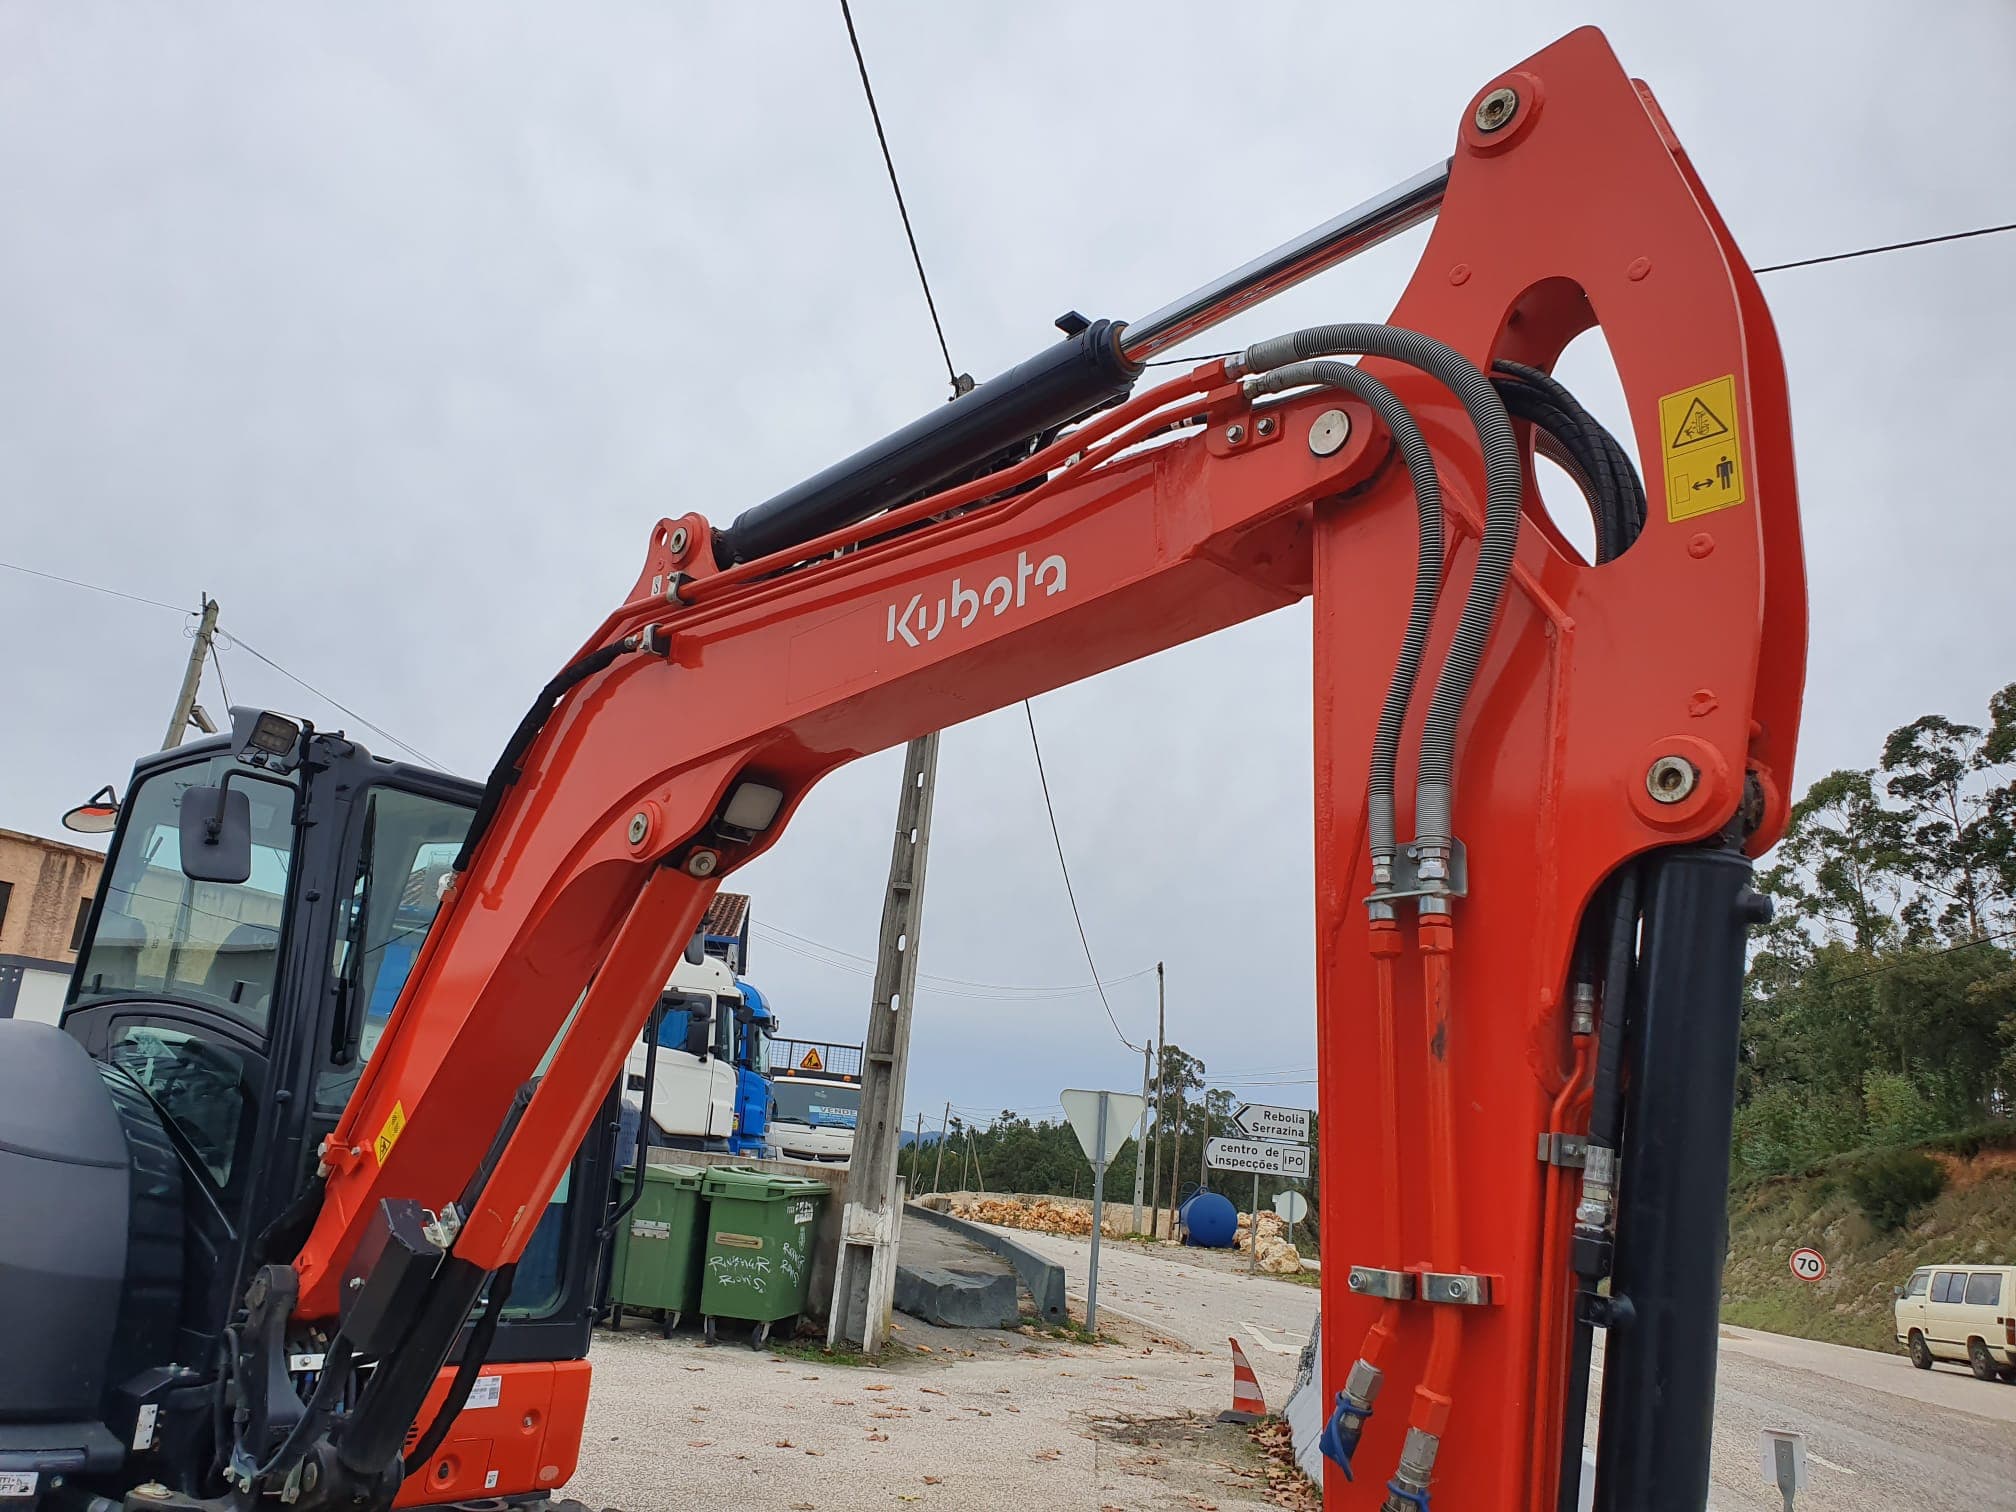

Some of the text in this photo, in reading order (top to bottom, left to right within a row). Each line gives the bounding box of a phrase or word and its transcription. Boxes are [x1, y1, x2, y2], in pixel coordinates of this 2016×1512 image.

[887, 551, 1067, 647] Kubota
[820, 1106, 857, 1116] VENDE
[1264, 1111, 1305, 1124] Rebolia
[1252, 1122, 1304, 1137] Serrazina
[1220, 1144, 1279, 1157] centro de
[1215, 1154, 1279, 1171] inspecções
[1284, 1155, 1303, 1166] IPO
[1797, 1257, 1819, 1272] 70
